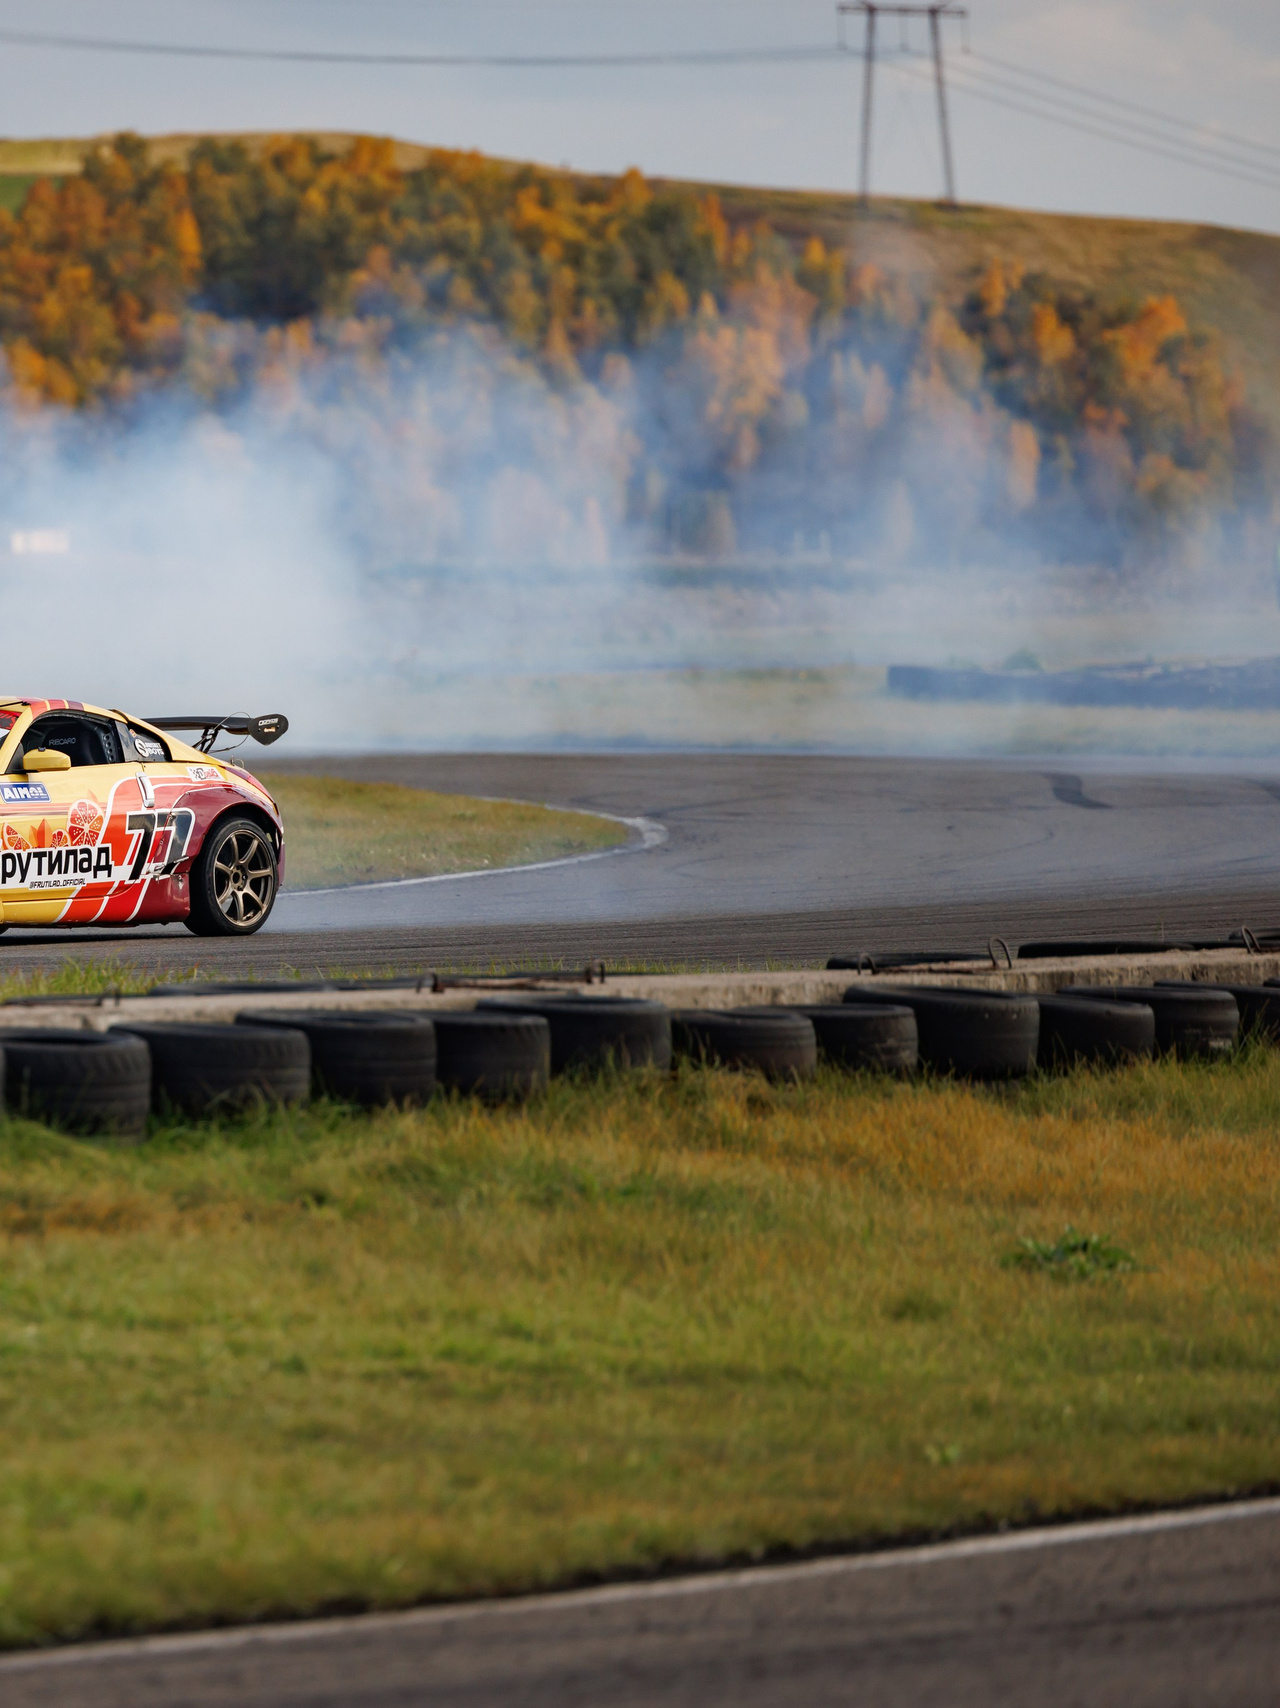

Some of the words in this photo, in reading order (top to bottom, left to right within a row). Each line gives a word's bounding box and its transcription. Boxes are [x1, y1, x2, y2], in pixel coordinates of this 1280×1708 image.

[48, 737, 77, 746] RECARO
[4, 786, 48, 799] AIMOL
[127, 810, 194, 880] 77
